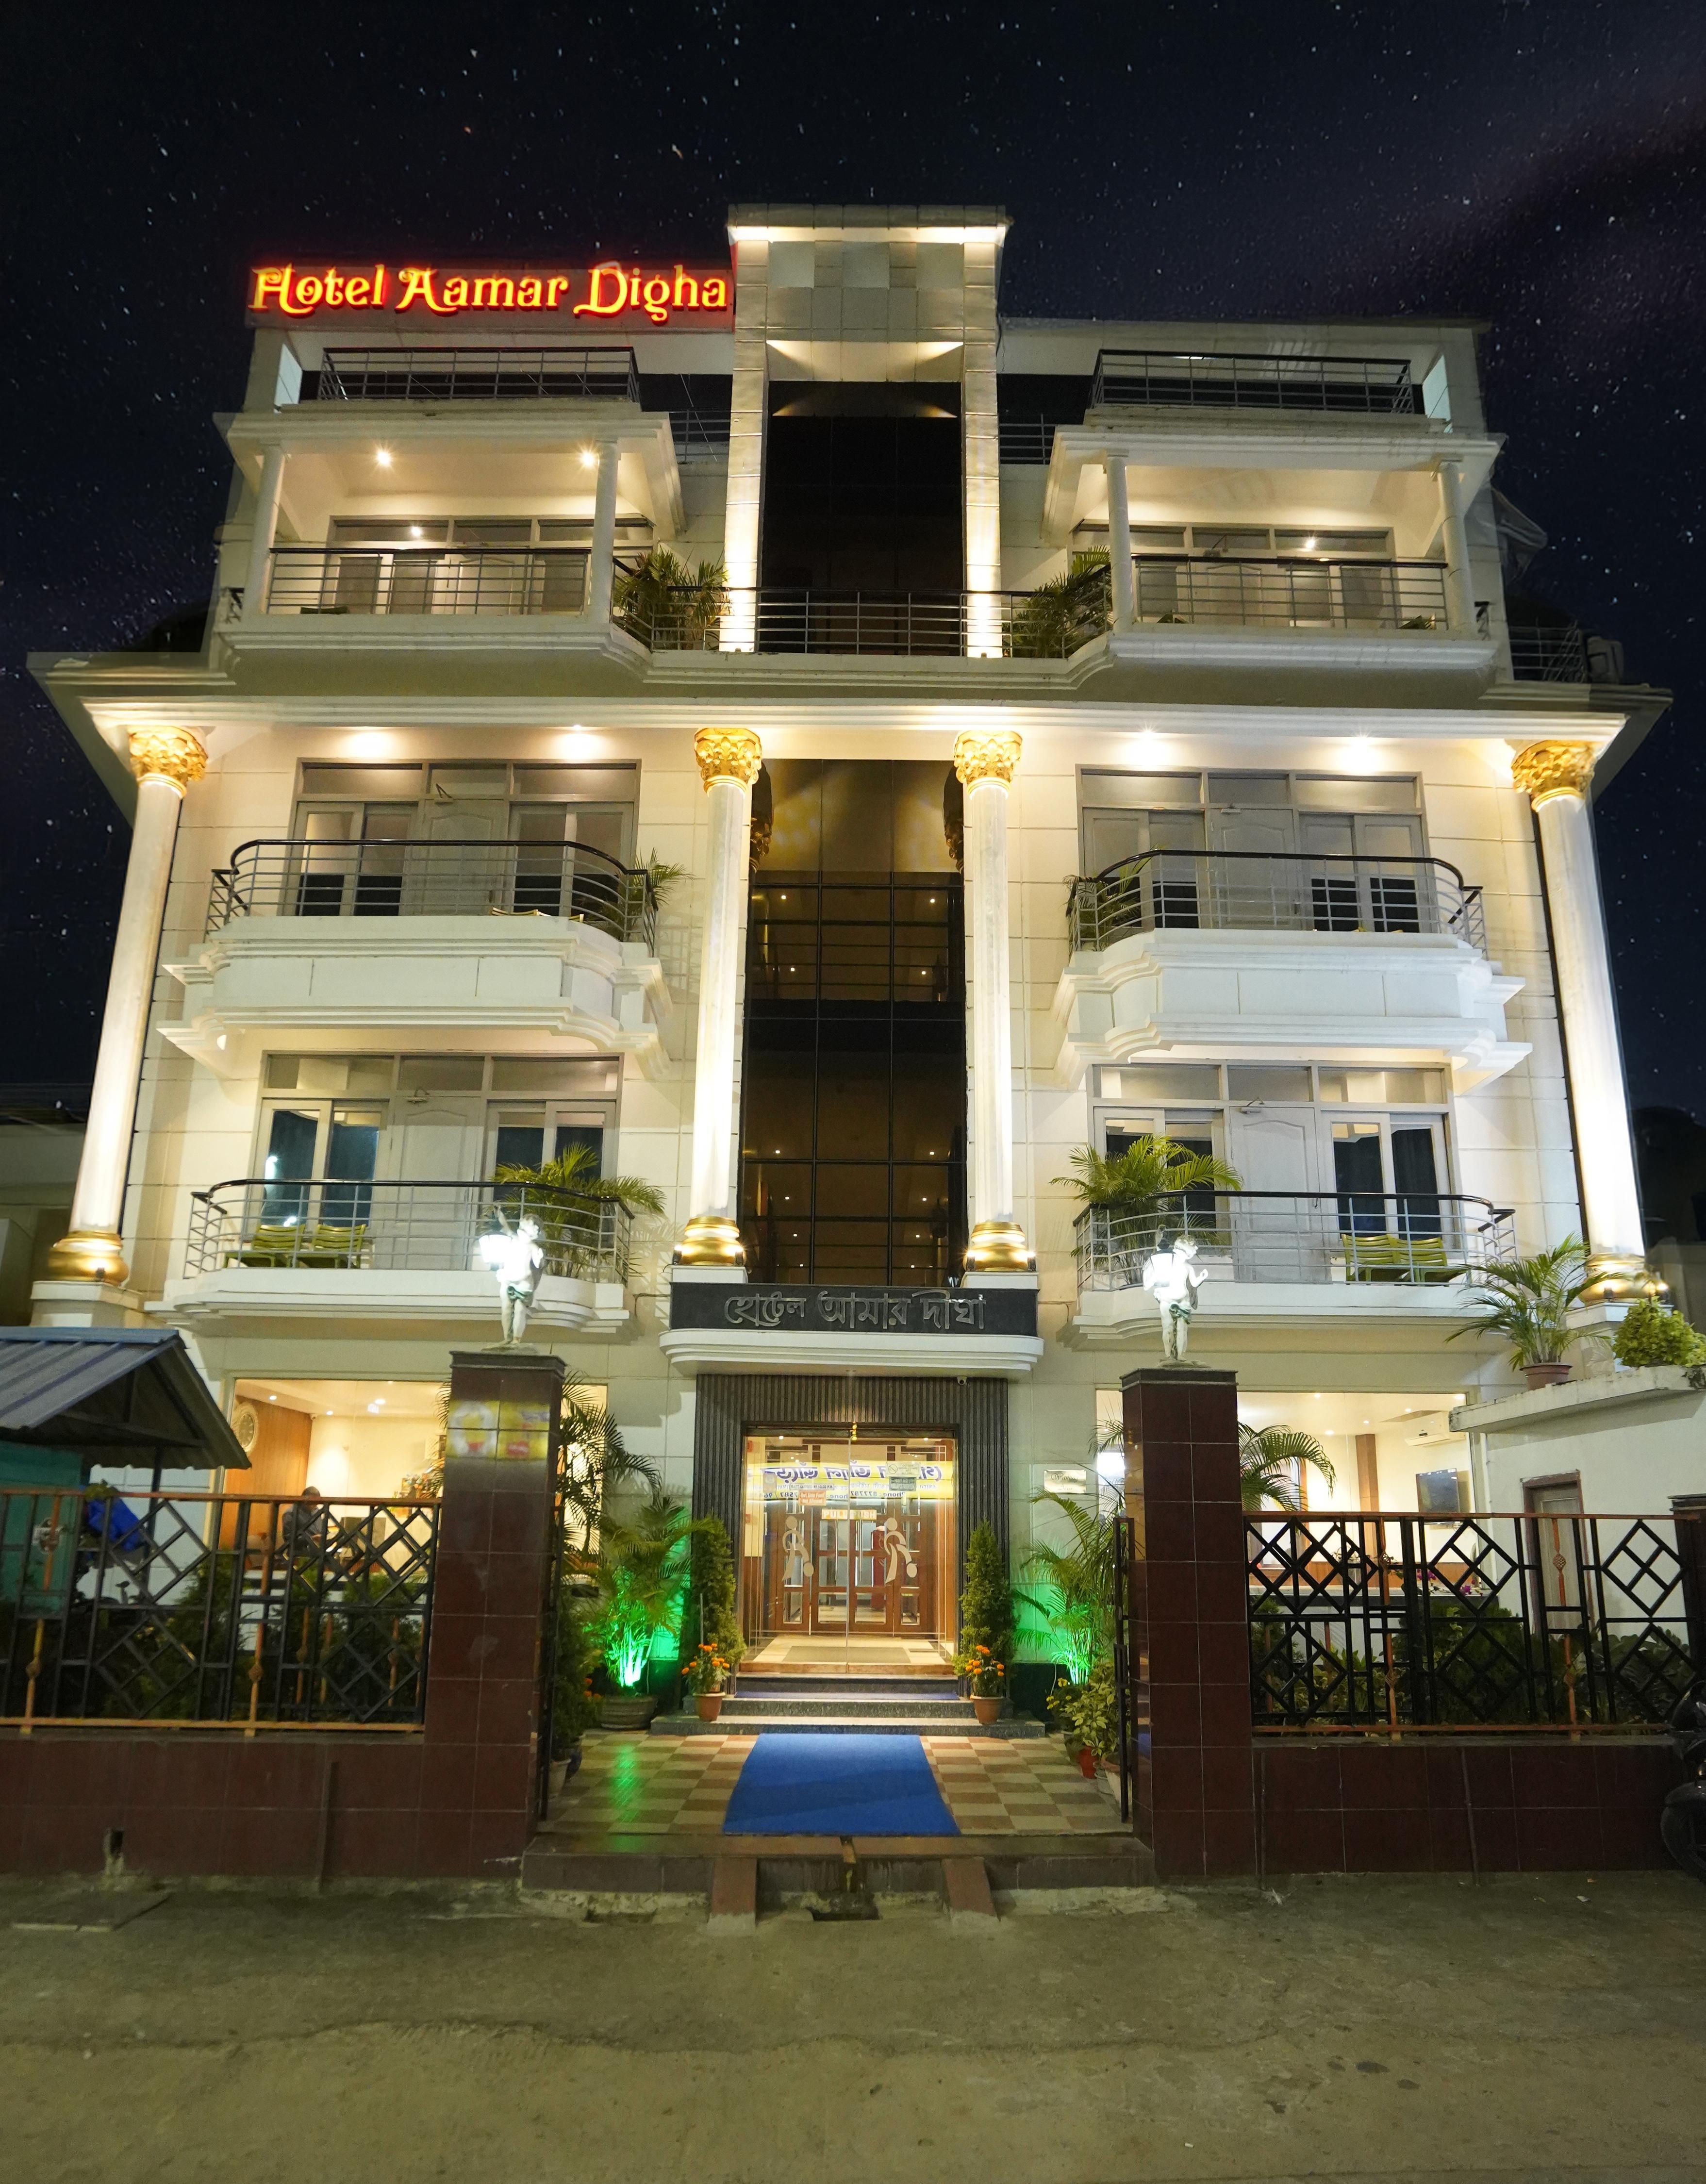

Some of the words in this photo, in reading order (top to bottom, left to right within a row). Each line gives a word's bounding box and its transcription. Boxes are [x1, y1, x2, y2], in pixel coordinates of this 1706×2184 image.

[248, 264, 384, 314] Hotel
[394, 267, 569, 314] Aamar
[573, 261, 728, 322] Digha
[724, 1291, 807, 1327] হোটেল
[817, 1290, 913, 1329] আমার
[912, 1289, 986, 1329] দীঘা
[823, 1510, 847, 1519] PULL
[852, 1510, 876, 1519] PUSH
